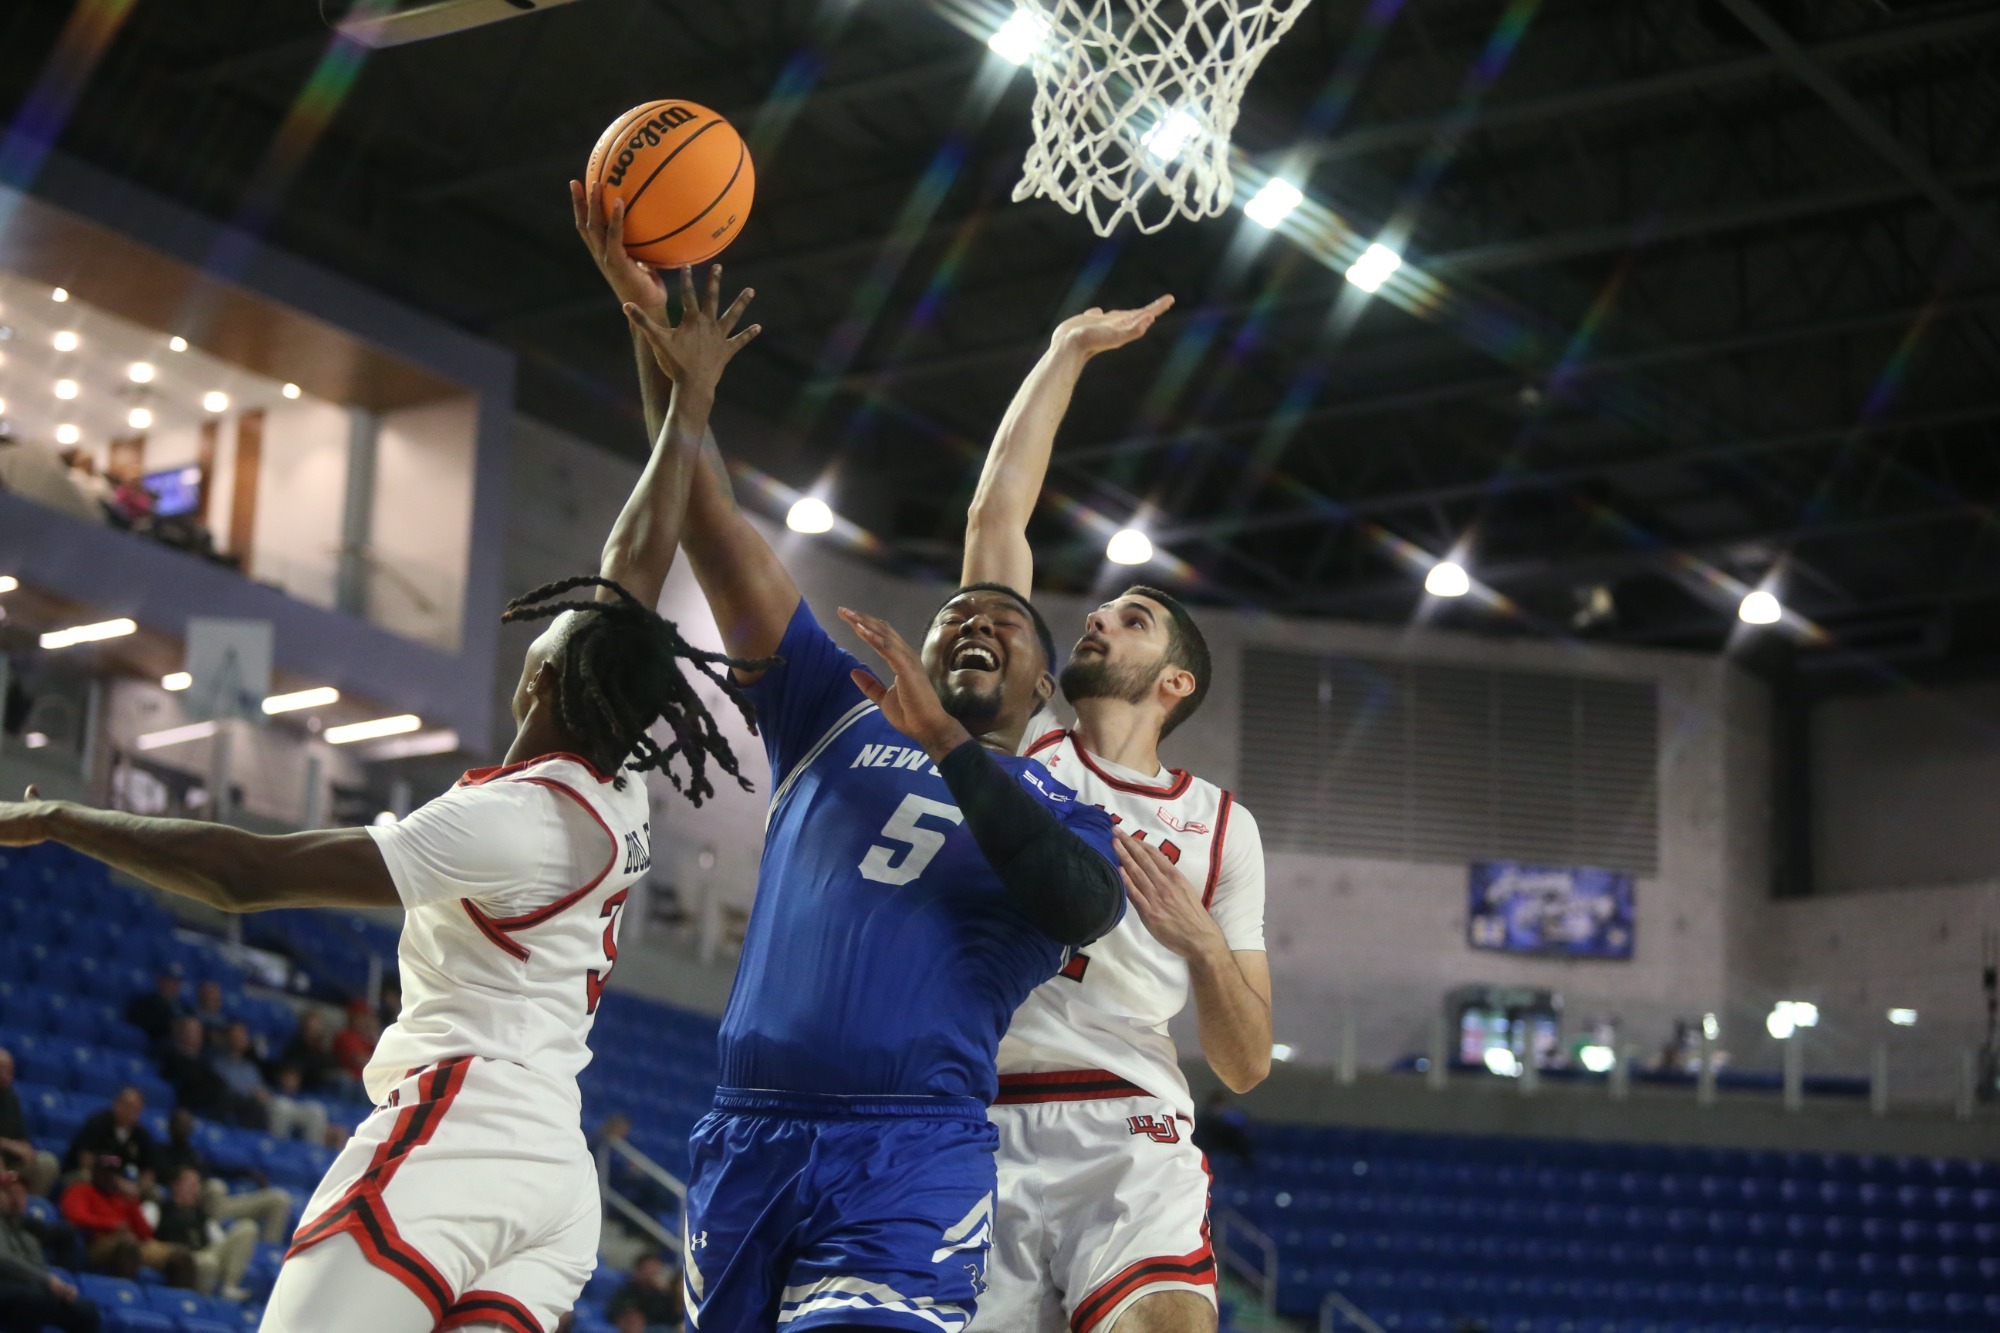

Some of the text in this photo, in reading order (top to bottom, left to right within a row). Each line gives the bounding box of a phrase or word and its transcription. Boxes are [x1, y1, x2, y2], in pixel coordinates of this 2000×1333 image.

[607, 106, 698, 187] Wilson
[711, 214, 736, 239] SLC
[849, 744, 930, 771] NEW
[1023, 770, 1072, 803] SLC
[858, 793, 965, 886] 5
[1126, 1114, 1180, 1144] LU
